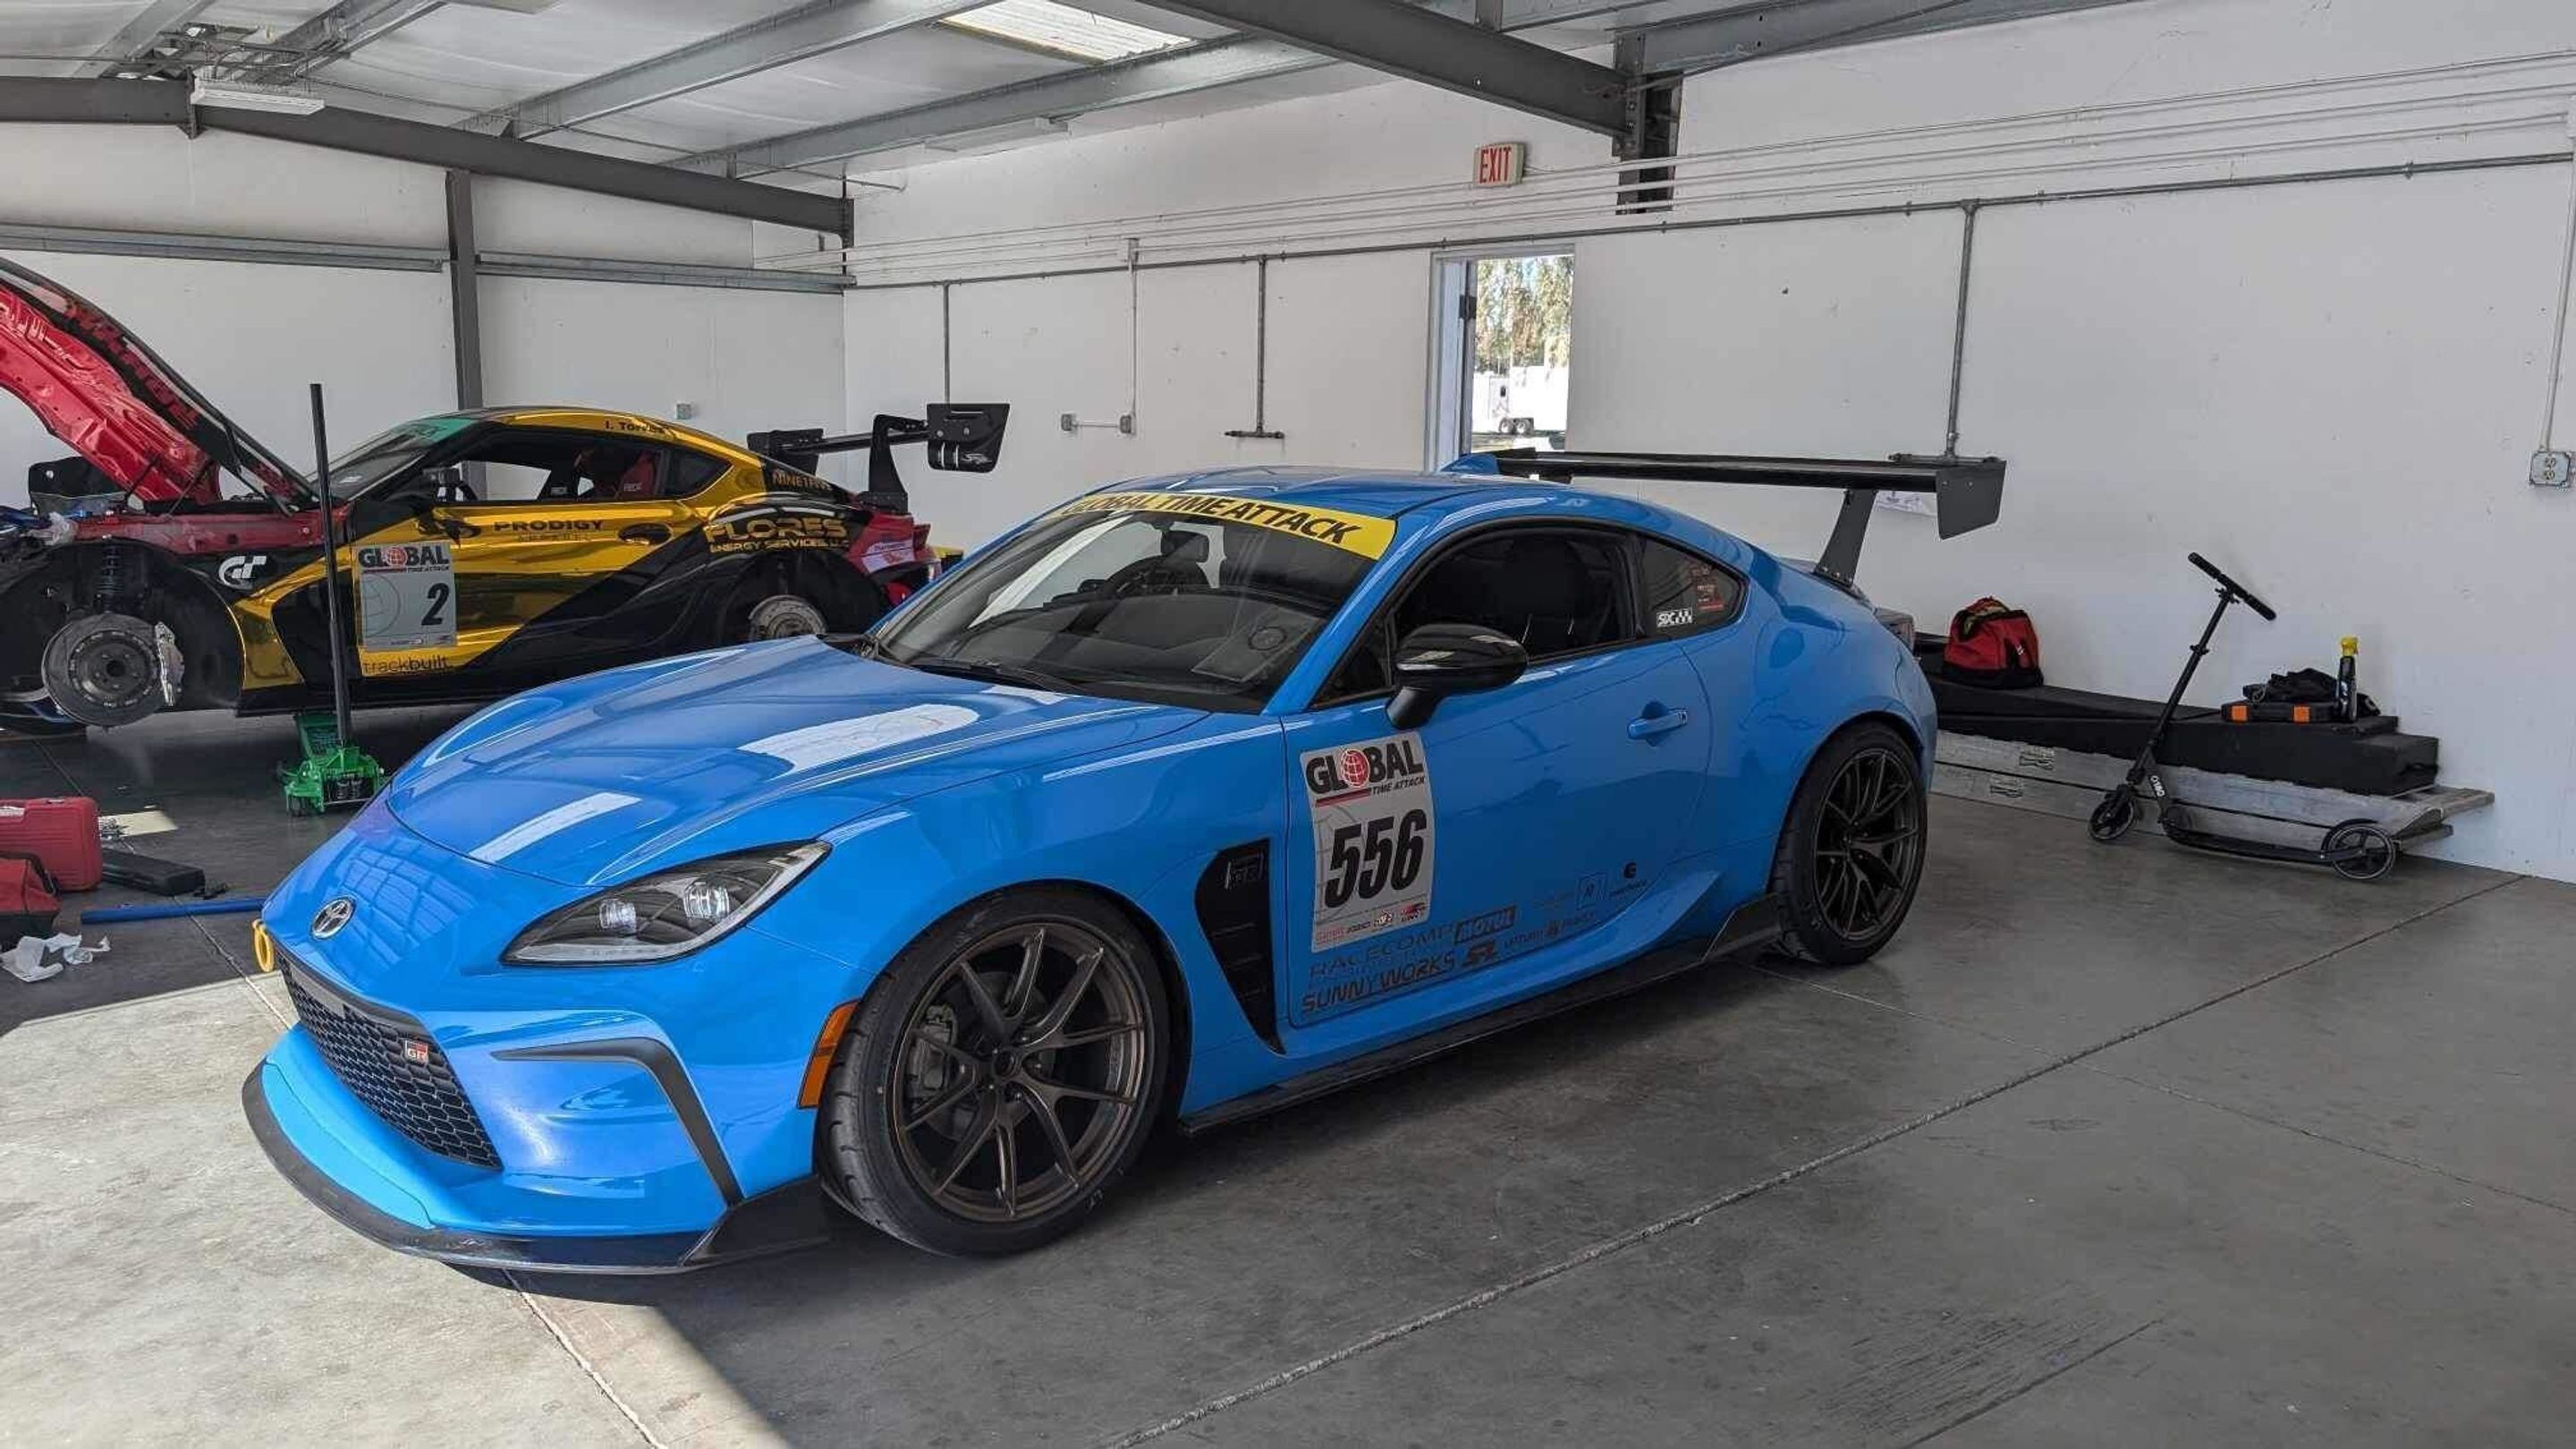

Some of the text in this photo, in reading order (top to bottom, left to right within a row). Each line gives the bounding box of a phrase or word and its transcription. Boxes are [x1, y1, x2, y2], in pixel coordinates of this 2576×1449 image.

[1479, 147, 1512, 183] EXIT
[494, 520, 603, 531] PRODIGY
[703, 518, 848, 543] FLORES
[1155, 496, 1235, 515] TIME
[1222, 502, 1361, 544] ATTACK
[358, 546, 450, 568] GLOBAL
[710, 541, 760, 554] ENERGY
[421, 583, 450, 626] 2
[362, 655, 447, 673] trackbuilt
[1306, 740, 1425, 794] GLOBAL
[1371, 775, 1425, 796] TIME ATTACK
[1325, 809, 1428, 909] 556
[1457, 907, 1517, 944] MOTUL
[407, 1047, 428, 1062] GR
